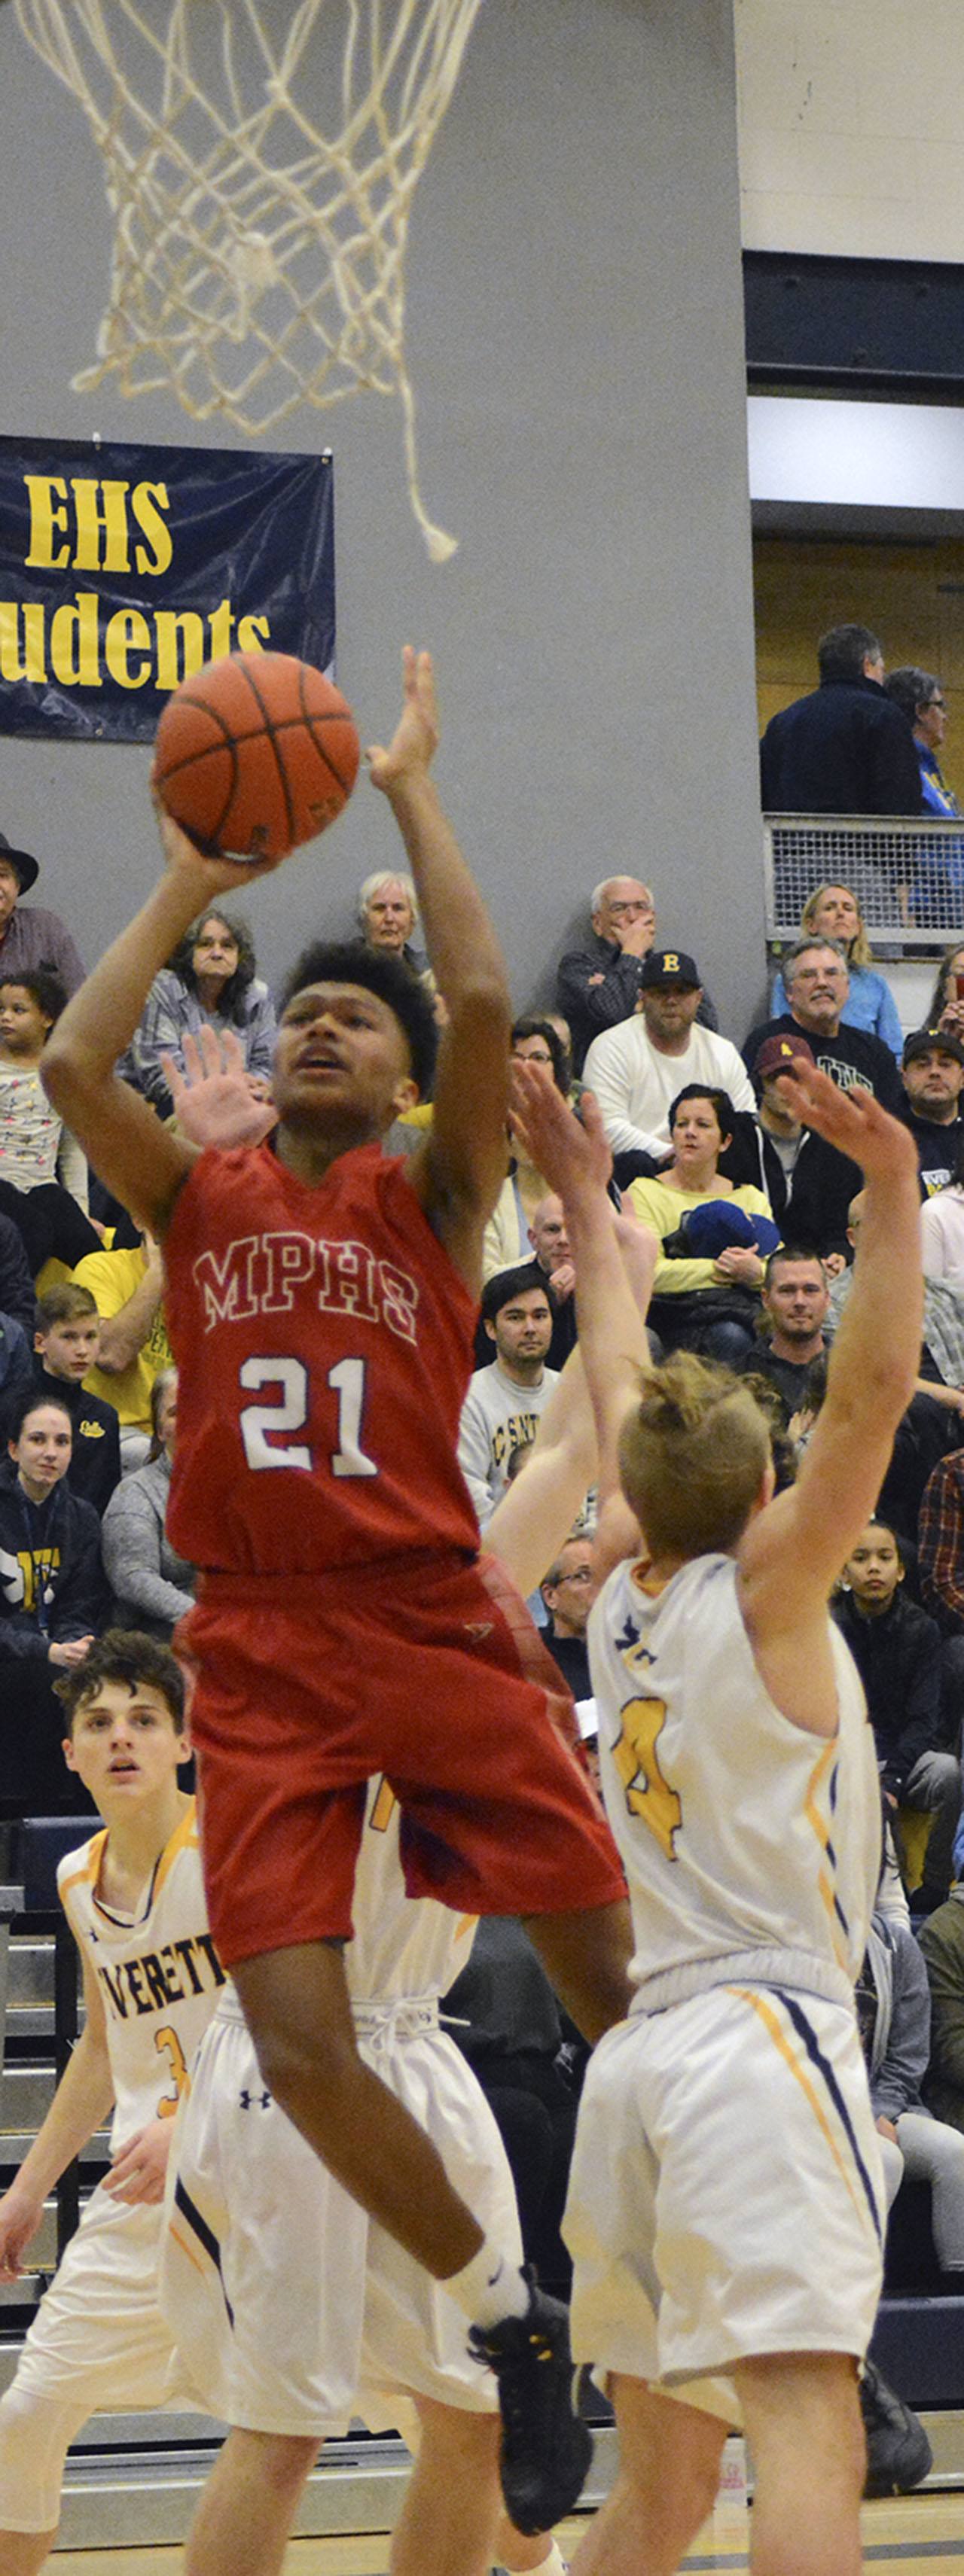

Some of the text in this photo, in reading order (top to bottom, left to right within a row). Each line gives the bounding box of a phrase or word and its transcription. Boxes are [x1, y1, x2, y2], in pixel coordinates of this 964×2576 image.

[23, 475, 173, 576] EHS
[663, 954, 680, 972] E
[193, 1232, 419, 1346] MPHS
[239, 1356, 378, 1476] 21
[611, 1696, 683, 1862] 4
[98, 1934, 227, 2020] VERETT
[154, 2025, 191, 2120] 3
